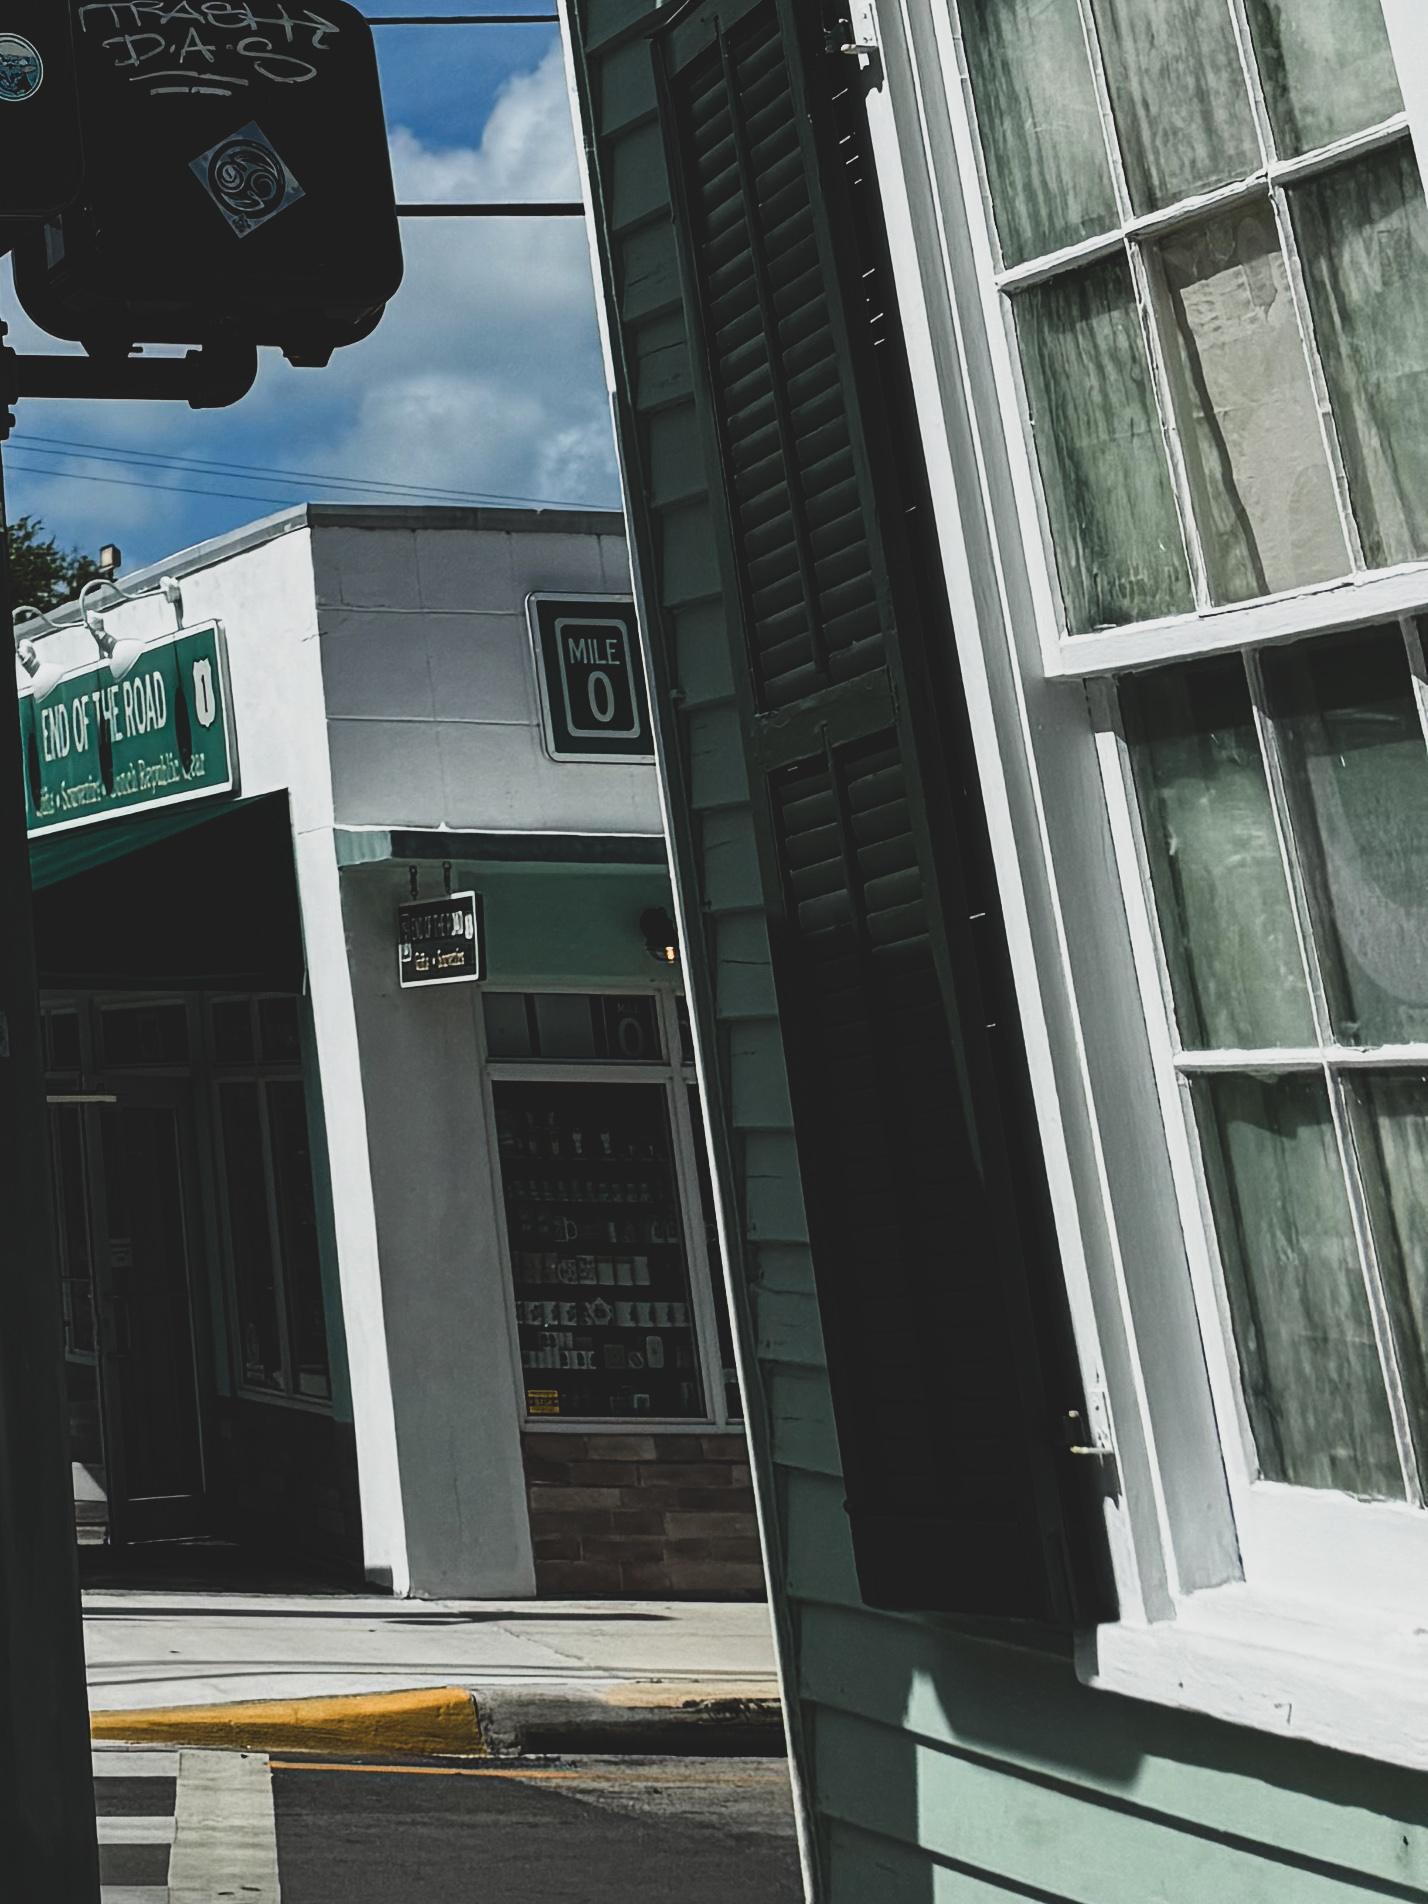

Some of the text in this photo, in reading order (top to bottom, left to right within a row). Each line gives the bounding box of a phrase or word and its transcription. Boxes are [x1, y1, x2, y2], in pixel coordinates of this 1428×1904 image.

[568, 637, 621, 666] MILE
[41, 703, 70, 763] END
[73, 694, 89, 752] OF
[124, 671, 167, 738] ROAD
[199, 674, 209, 714] 1
[588, 671, 616, 722] 0
[618, 1017, 645, 1057] 0
